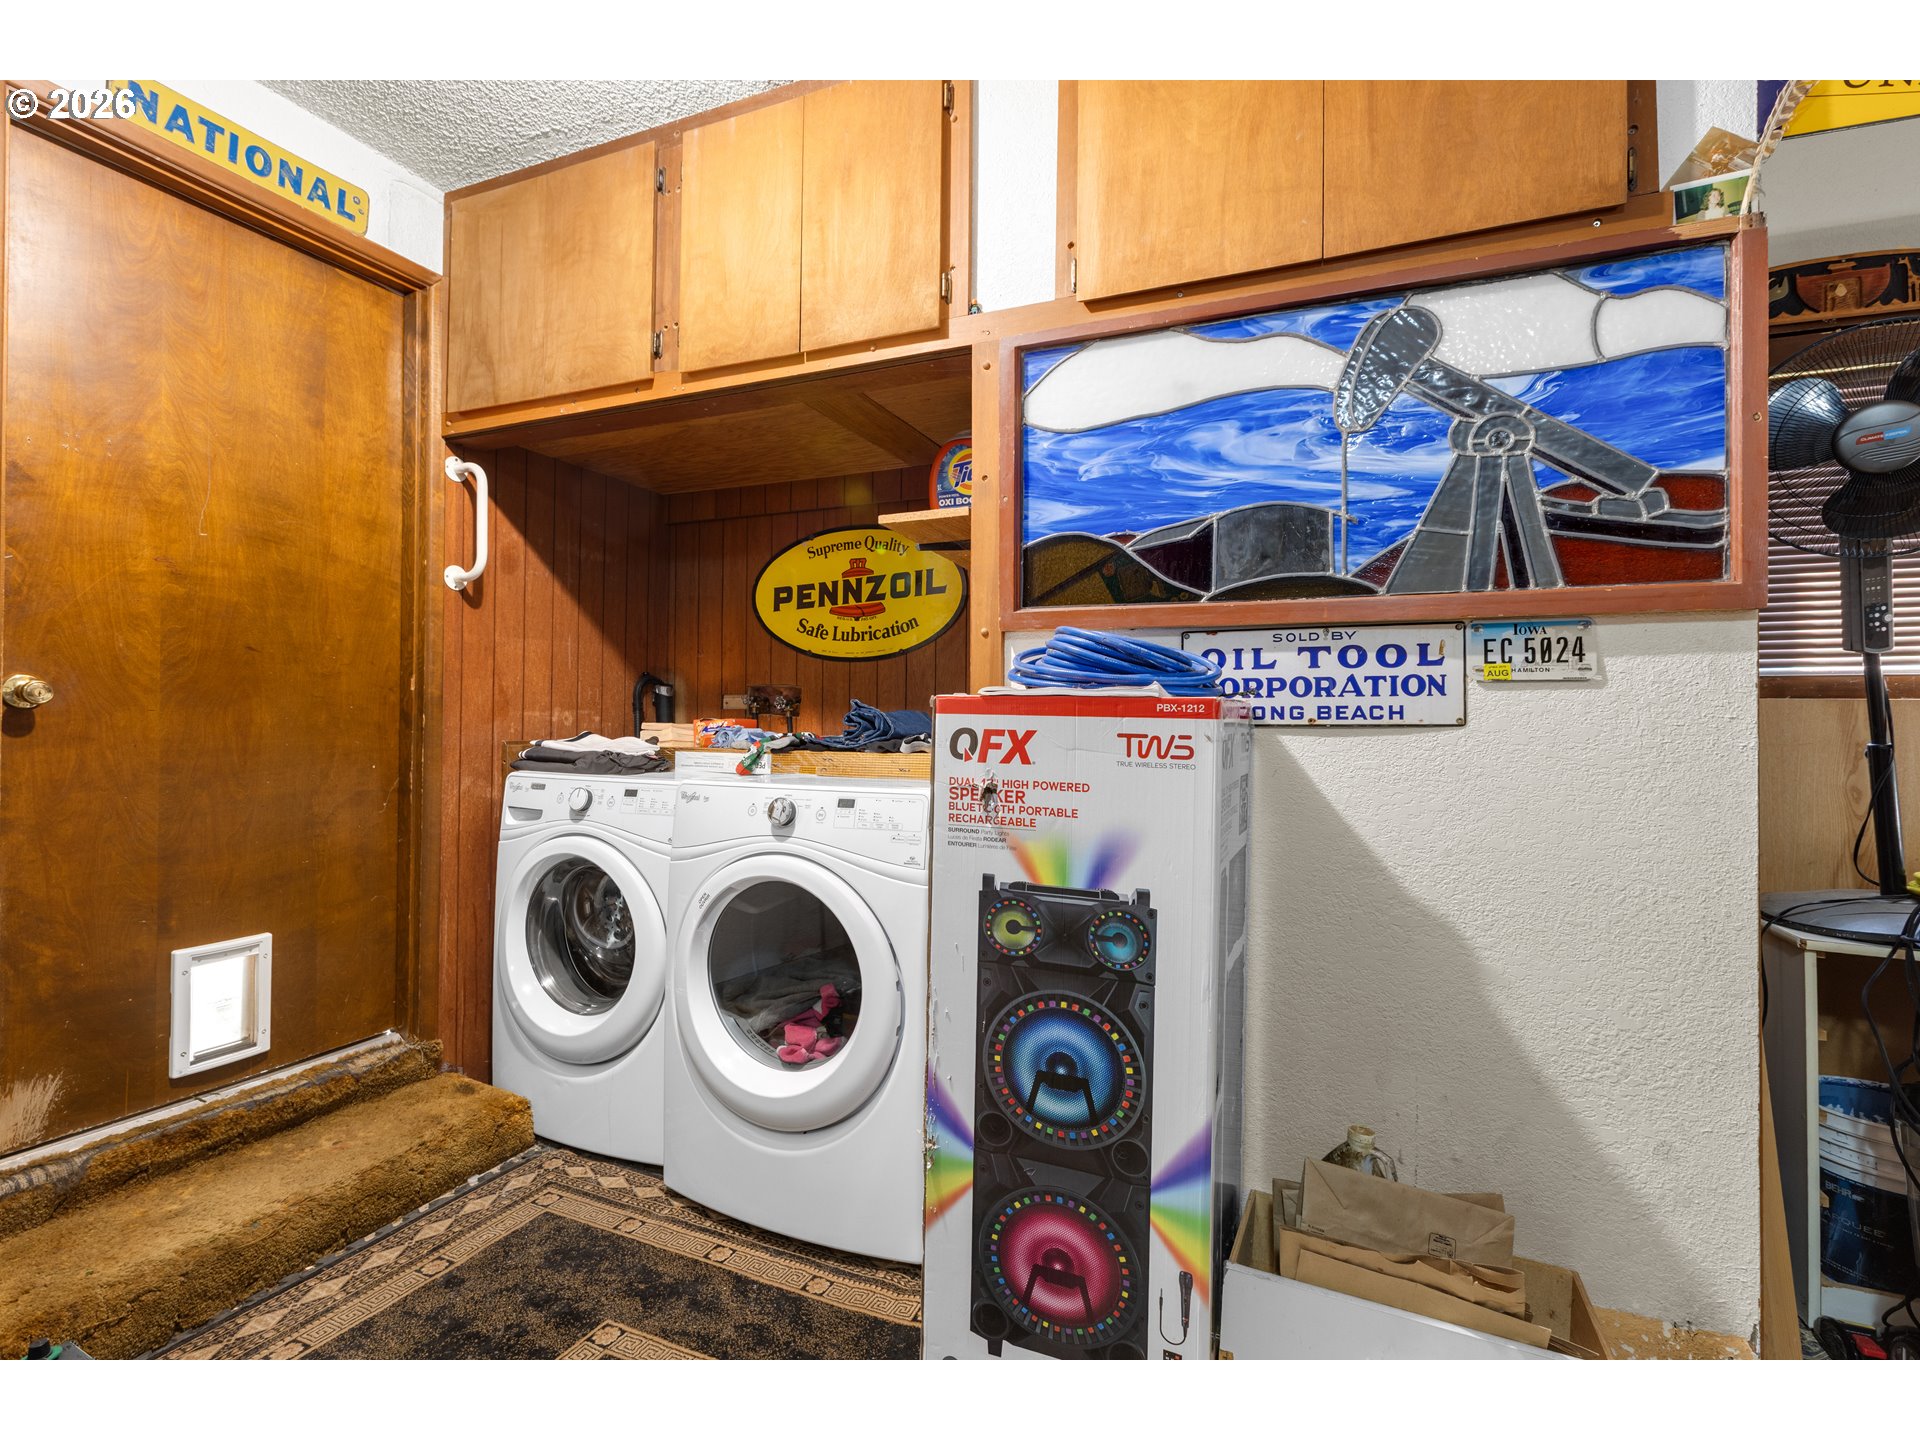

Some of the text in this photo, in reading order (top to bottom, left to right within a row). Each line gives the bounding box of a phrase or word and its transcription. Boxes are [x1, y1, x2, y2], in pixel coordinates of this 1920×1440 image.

[128, 80, 356, 223] NATIONAL
[952, 460, 972, 489] Ti
[938, 498, 954, 507] OXI
[807, 535, 909, 560] Supreme Quality
[773, 568, 948, 613] PENNZOIL
[796, 617, 919, 642] Safe Lubrication
[1273, 631, 1357, 643] SOLD BY
[1201, 643, 1446, 671] OIL TOOL
[1483, 636, 1586, 664] EC 5024
[1487, 669, 1509, 677] AUG
[1218, 673, 1448, 699] ORPORATION
[1156, 703, 1205, 713] PBX-1212
[1252, 705, 1305, 721] ONG
[1317, 704, 1404, 721] BEACH
[949, 727, 1038, 765] QFX
[1116, 733, 1195, 760] TWS
[949, 787, 1026, 805] SPEKER
[1002, 779, 1029, 790] HIGH
[1033, 780, 1091, 793] POWERED
[948, 813, 1037, 828] RECHARGEABLE
[1019, 805, 1079, 819] PORTABLE
[947, 826, 980, 834] SURROUND
[1821, 1209, 1886, 1239] ARQUEE
